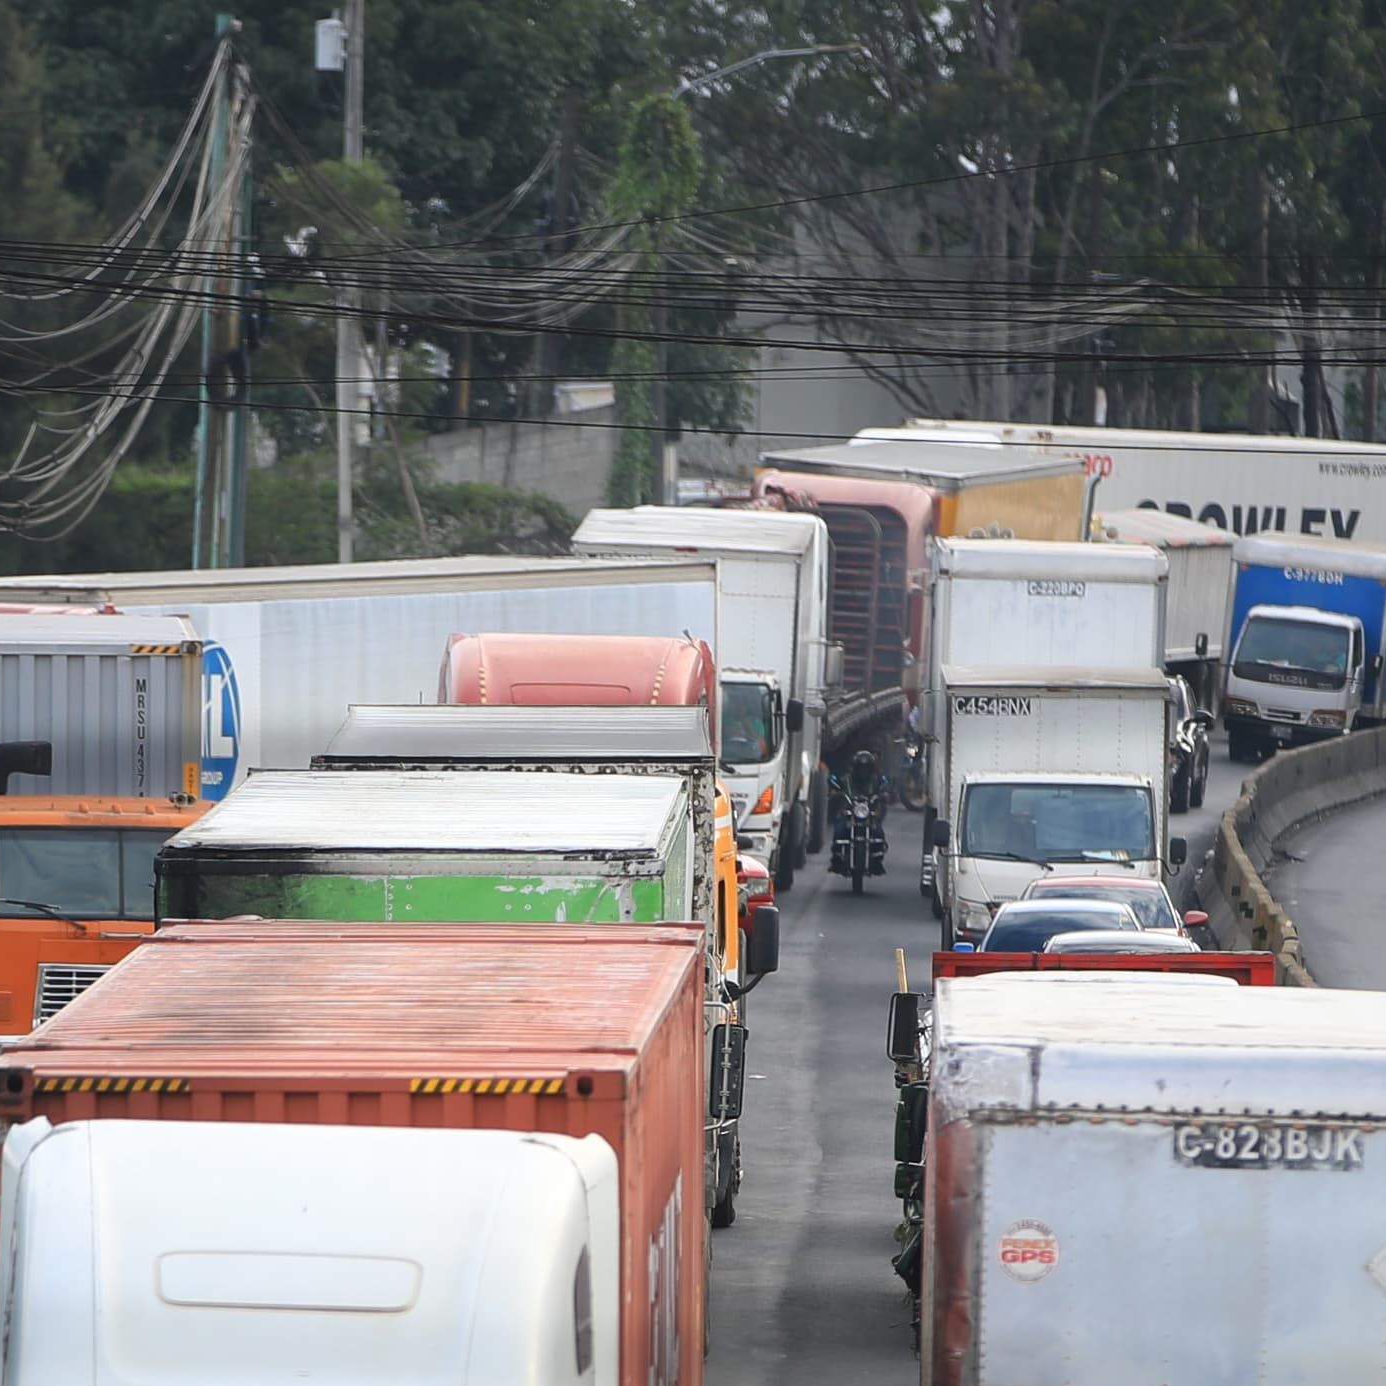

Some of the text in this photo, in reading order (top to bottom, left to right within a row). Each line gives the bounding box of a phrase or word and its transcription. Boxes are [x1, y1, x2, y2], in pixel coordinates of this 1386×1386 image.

[135, 679, 147, 797] MRSU 437
[1178, 1125, 1362, 1162] C-828BJK
[1001, 1249, 1056, 1264] GPS
